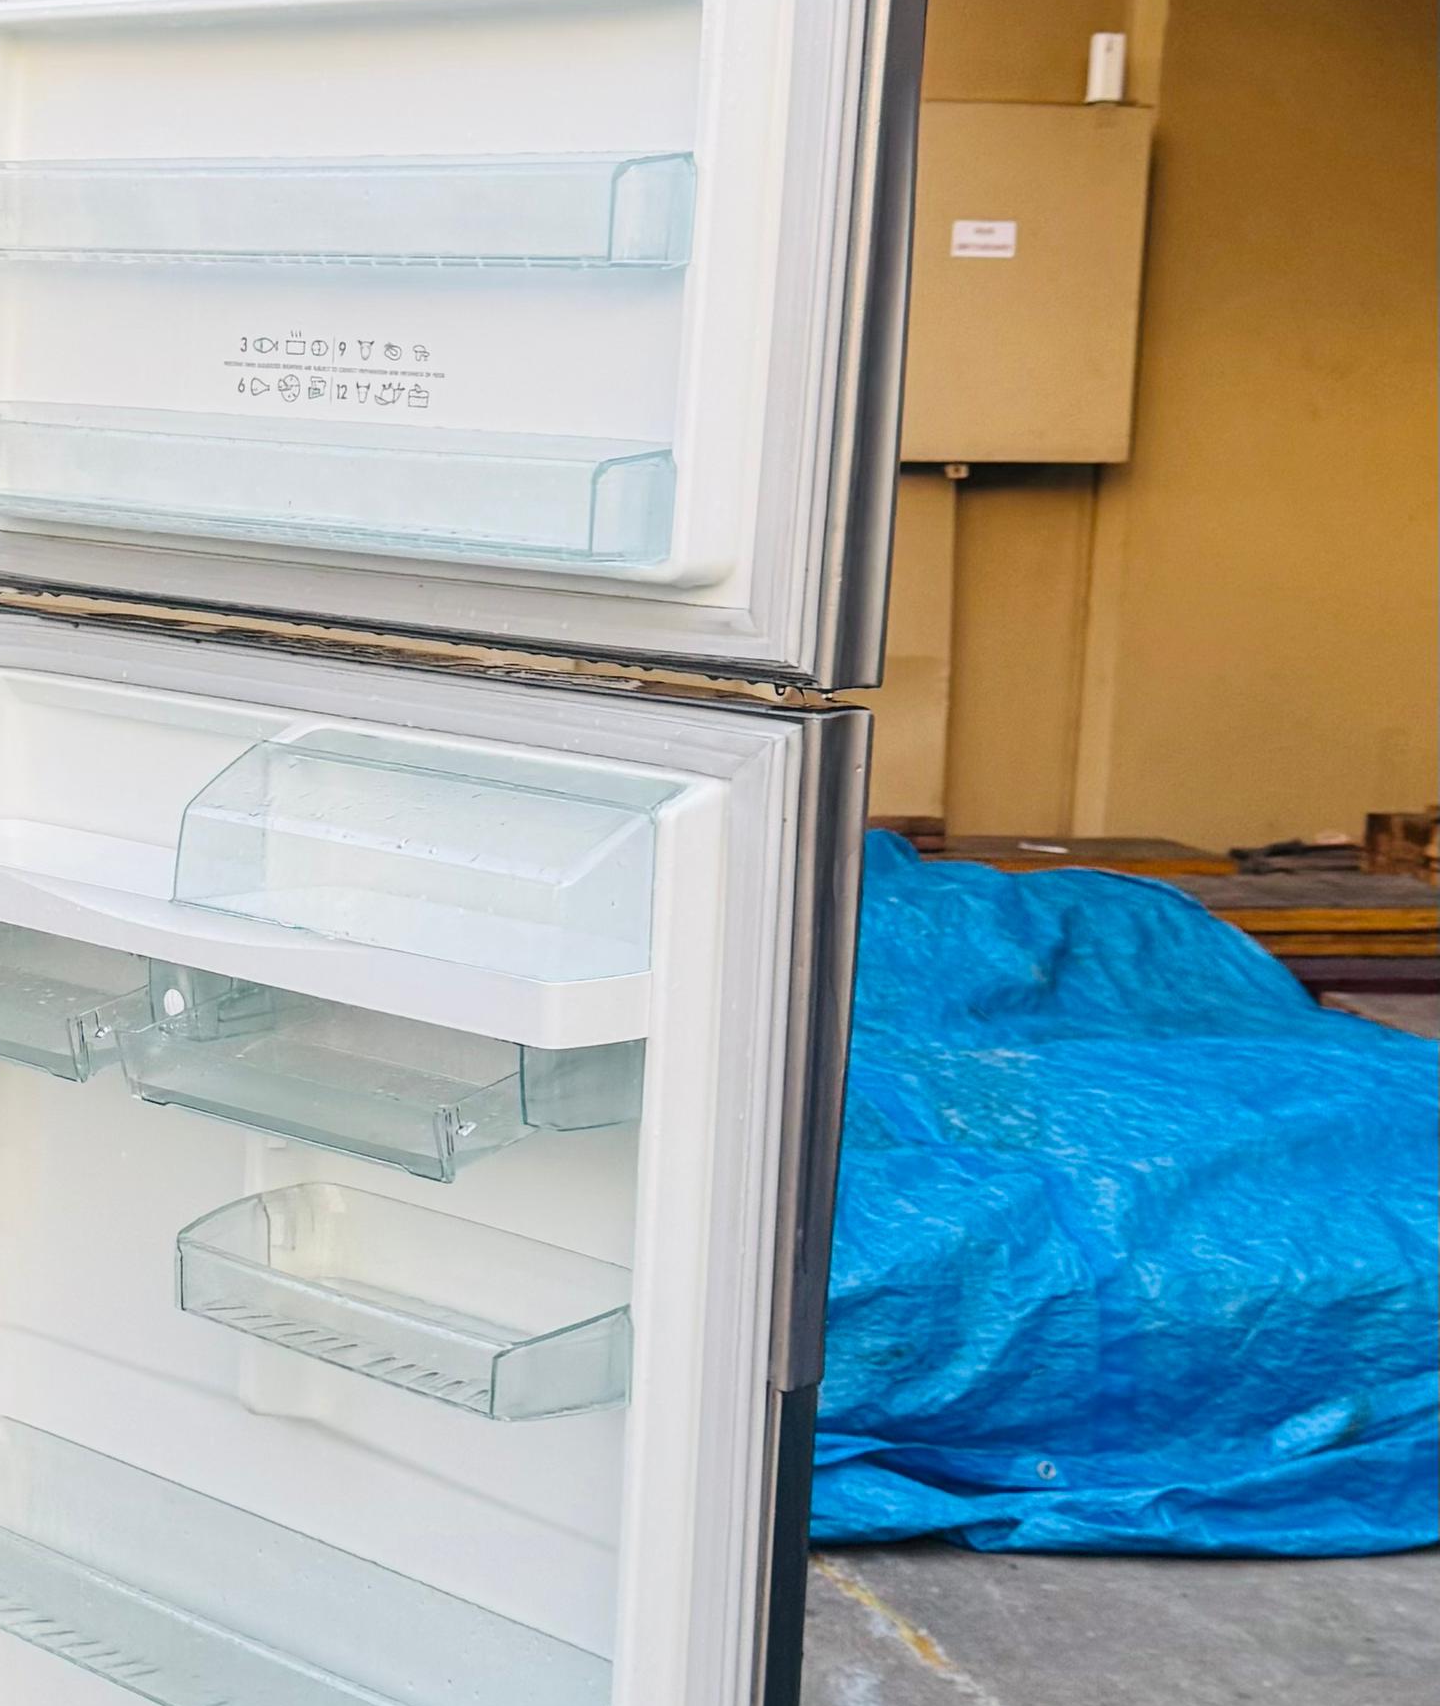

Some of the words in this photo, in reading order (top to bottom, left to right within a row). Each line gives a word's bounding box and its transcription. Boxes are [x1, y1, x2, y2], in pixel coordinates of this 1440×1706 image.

[240, 337, 248, 353] 3
[338, 341, 347, 357] 9
[237, 377, 246, 393] 6
[336, 384, 348, 400] 12
